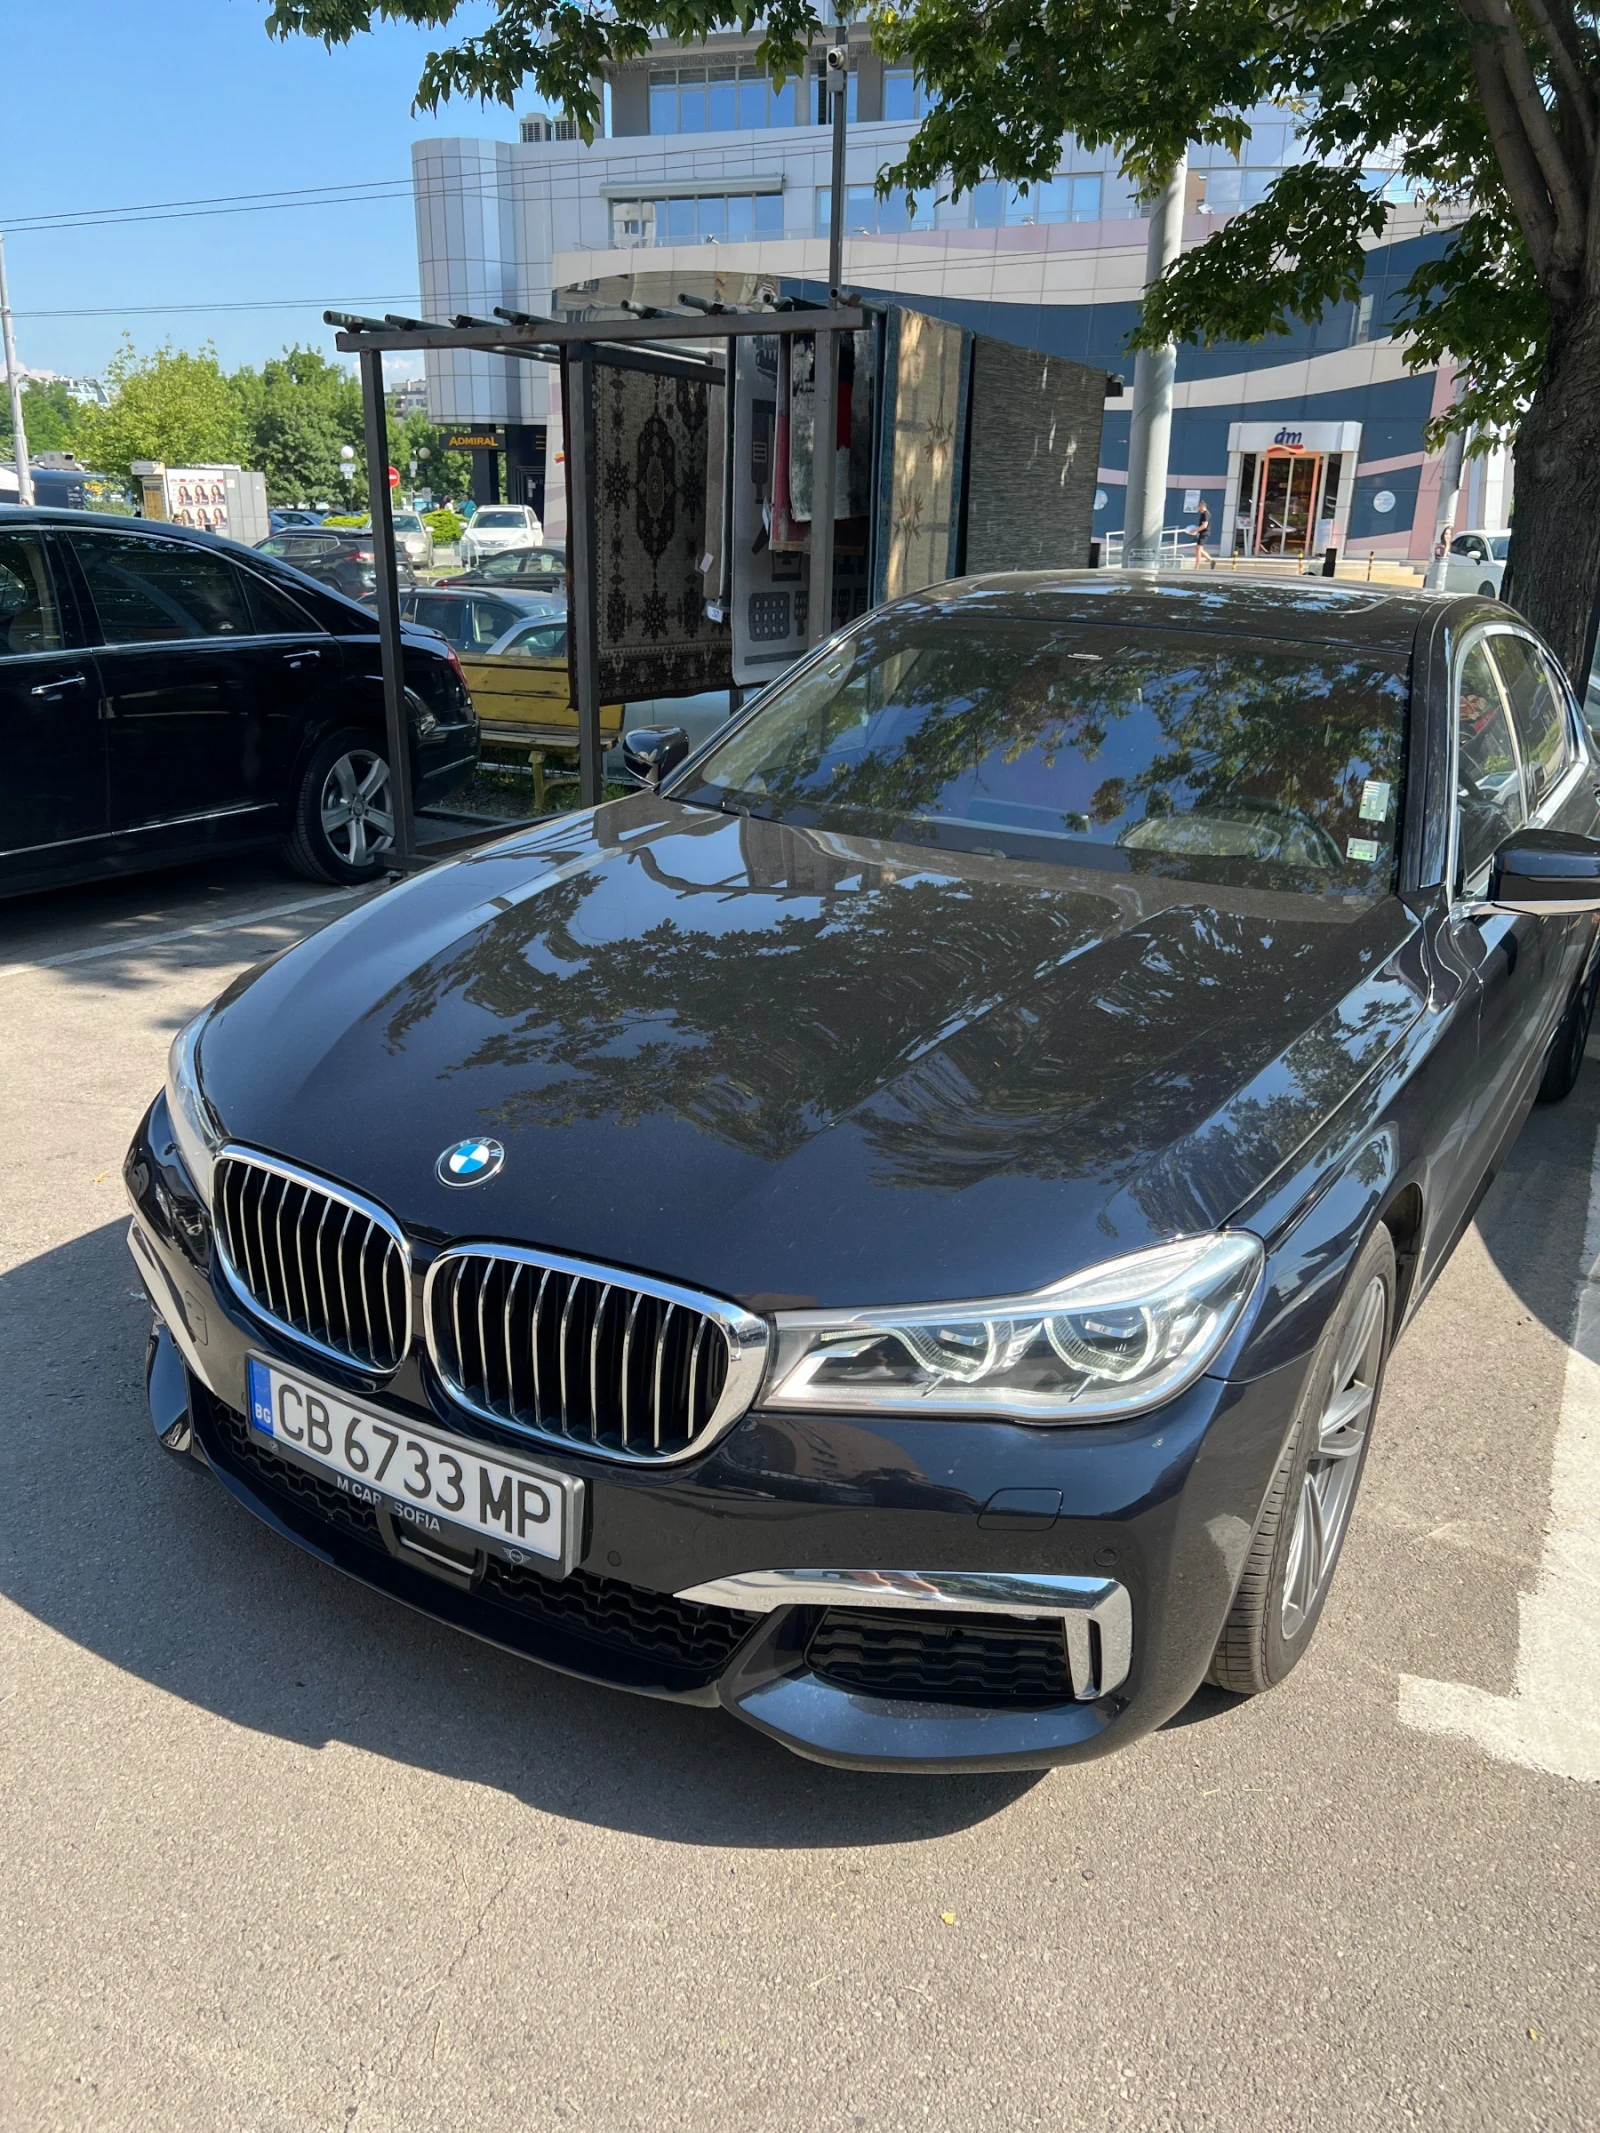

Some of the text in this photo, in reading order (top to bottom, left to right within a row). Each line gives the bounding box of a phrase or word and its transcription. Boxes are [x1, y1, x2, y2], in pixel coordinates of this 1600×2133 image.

[448, 436, 499, 447] ADMIRAL
[1274, 427, 1302, 444] dm
[254, 1402, 271, 1424] BG
[278, 1384, 551, 1538] CB 6733 MP
[336, 1475, 441, 1534] M CAR SOFIA
